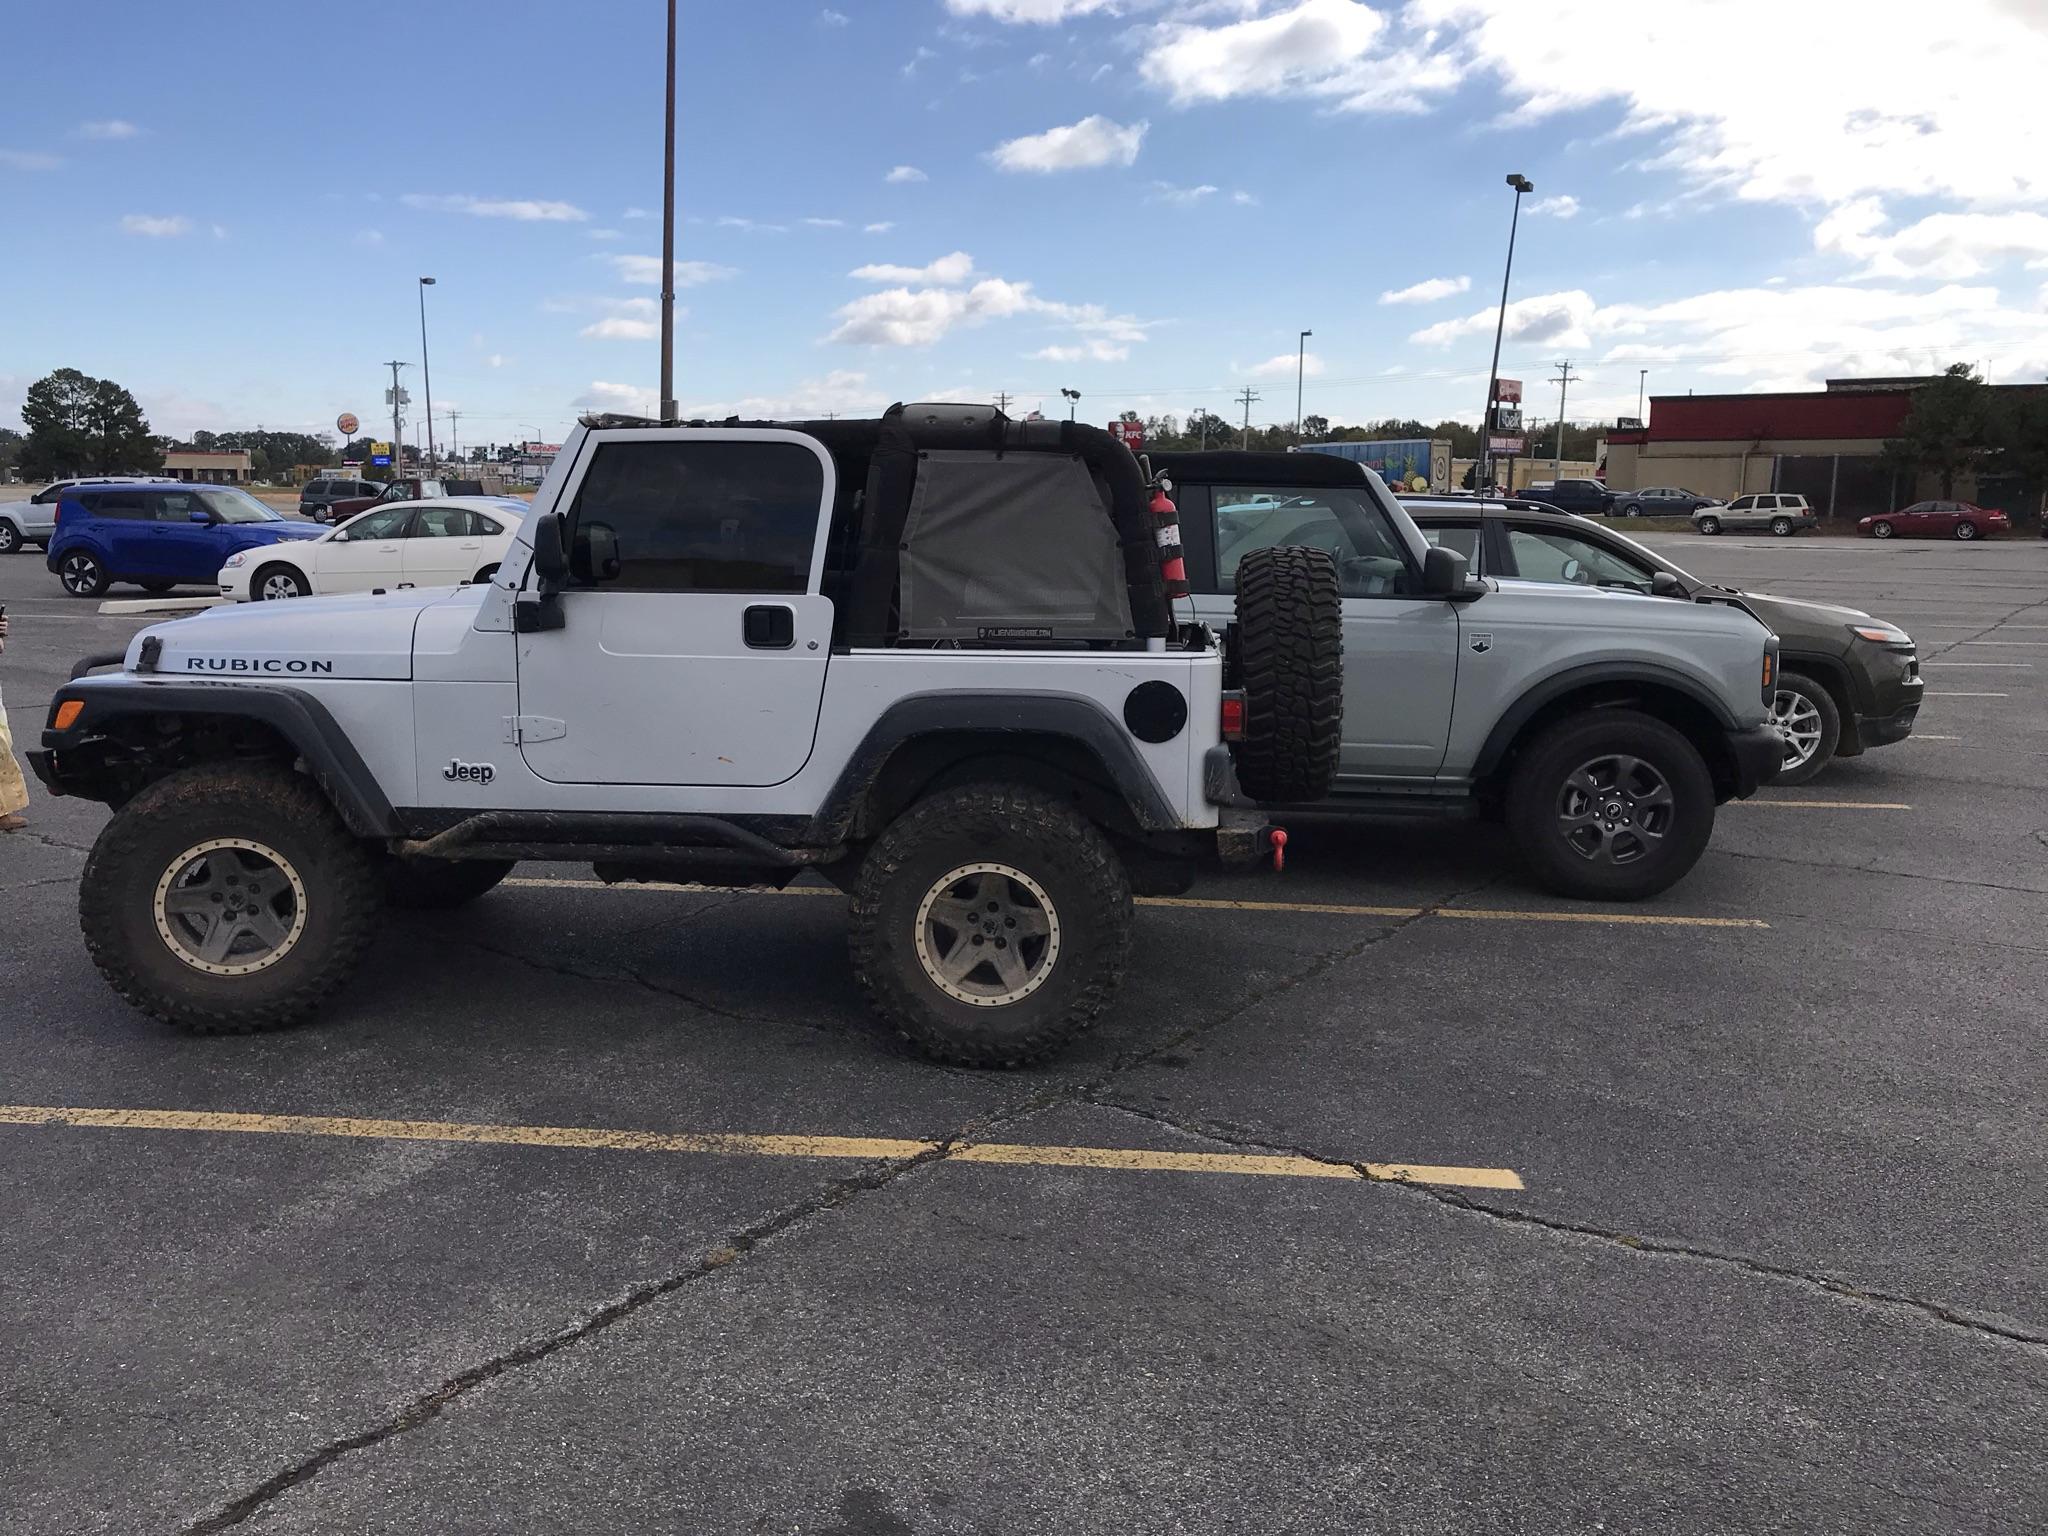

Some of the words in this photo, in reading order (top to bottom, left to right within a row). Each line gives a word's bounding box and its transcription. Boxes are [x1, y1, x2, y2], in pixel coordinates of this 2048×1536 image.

[1125, 431, 1142, 439] KFC
[187, 657, 332, 673] RUBICON
[443, 760, 494, 783] Jeep
